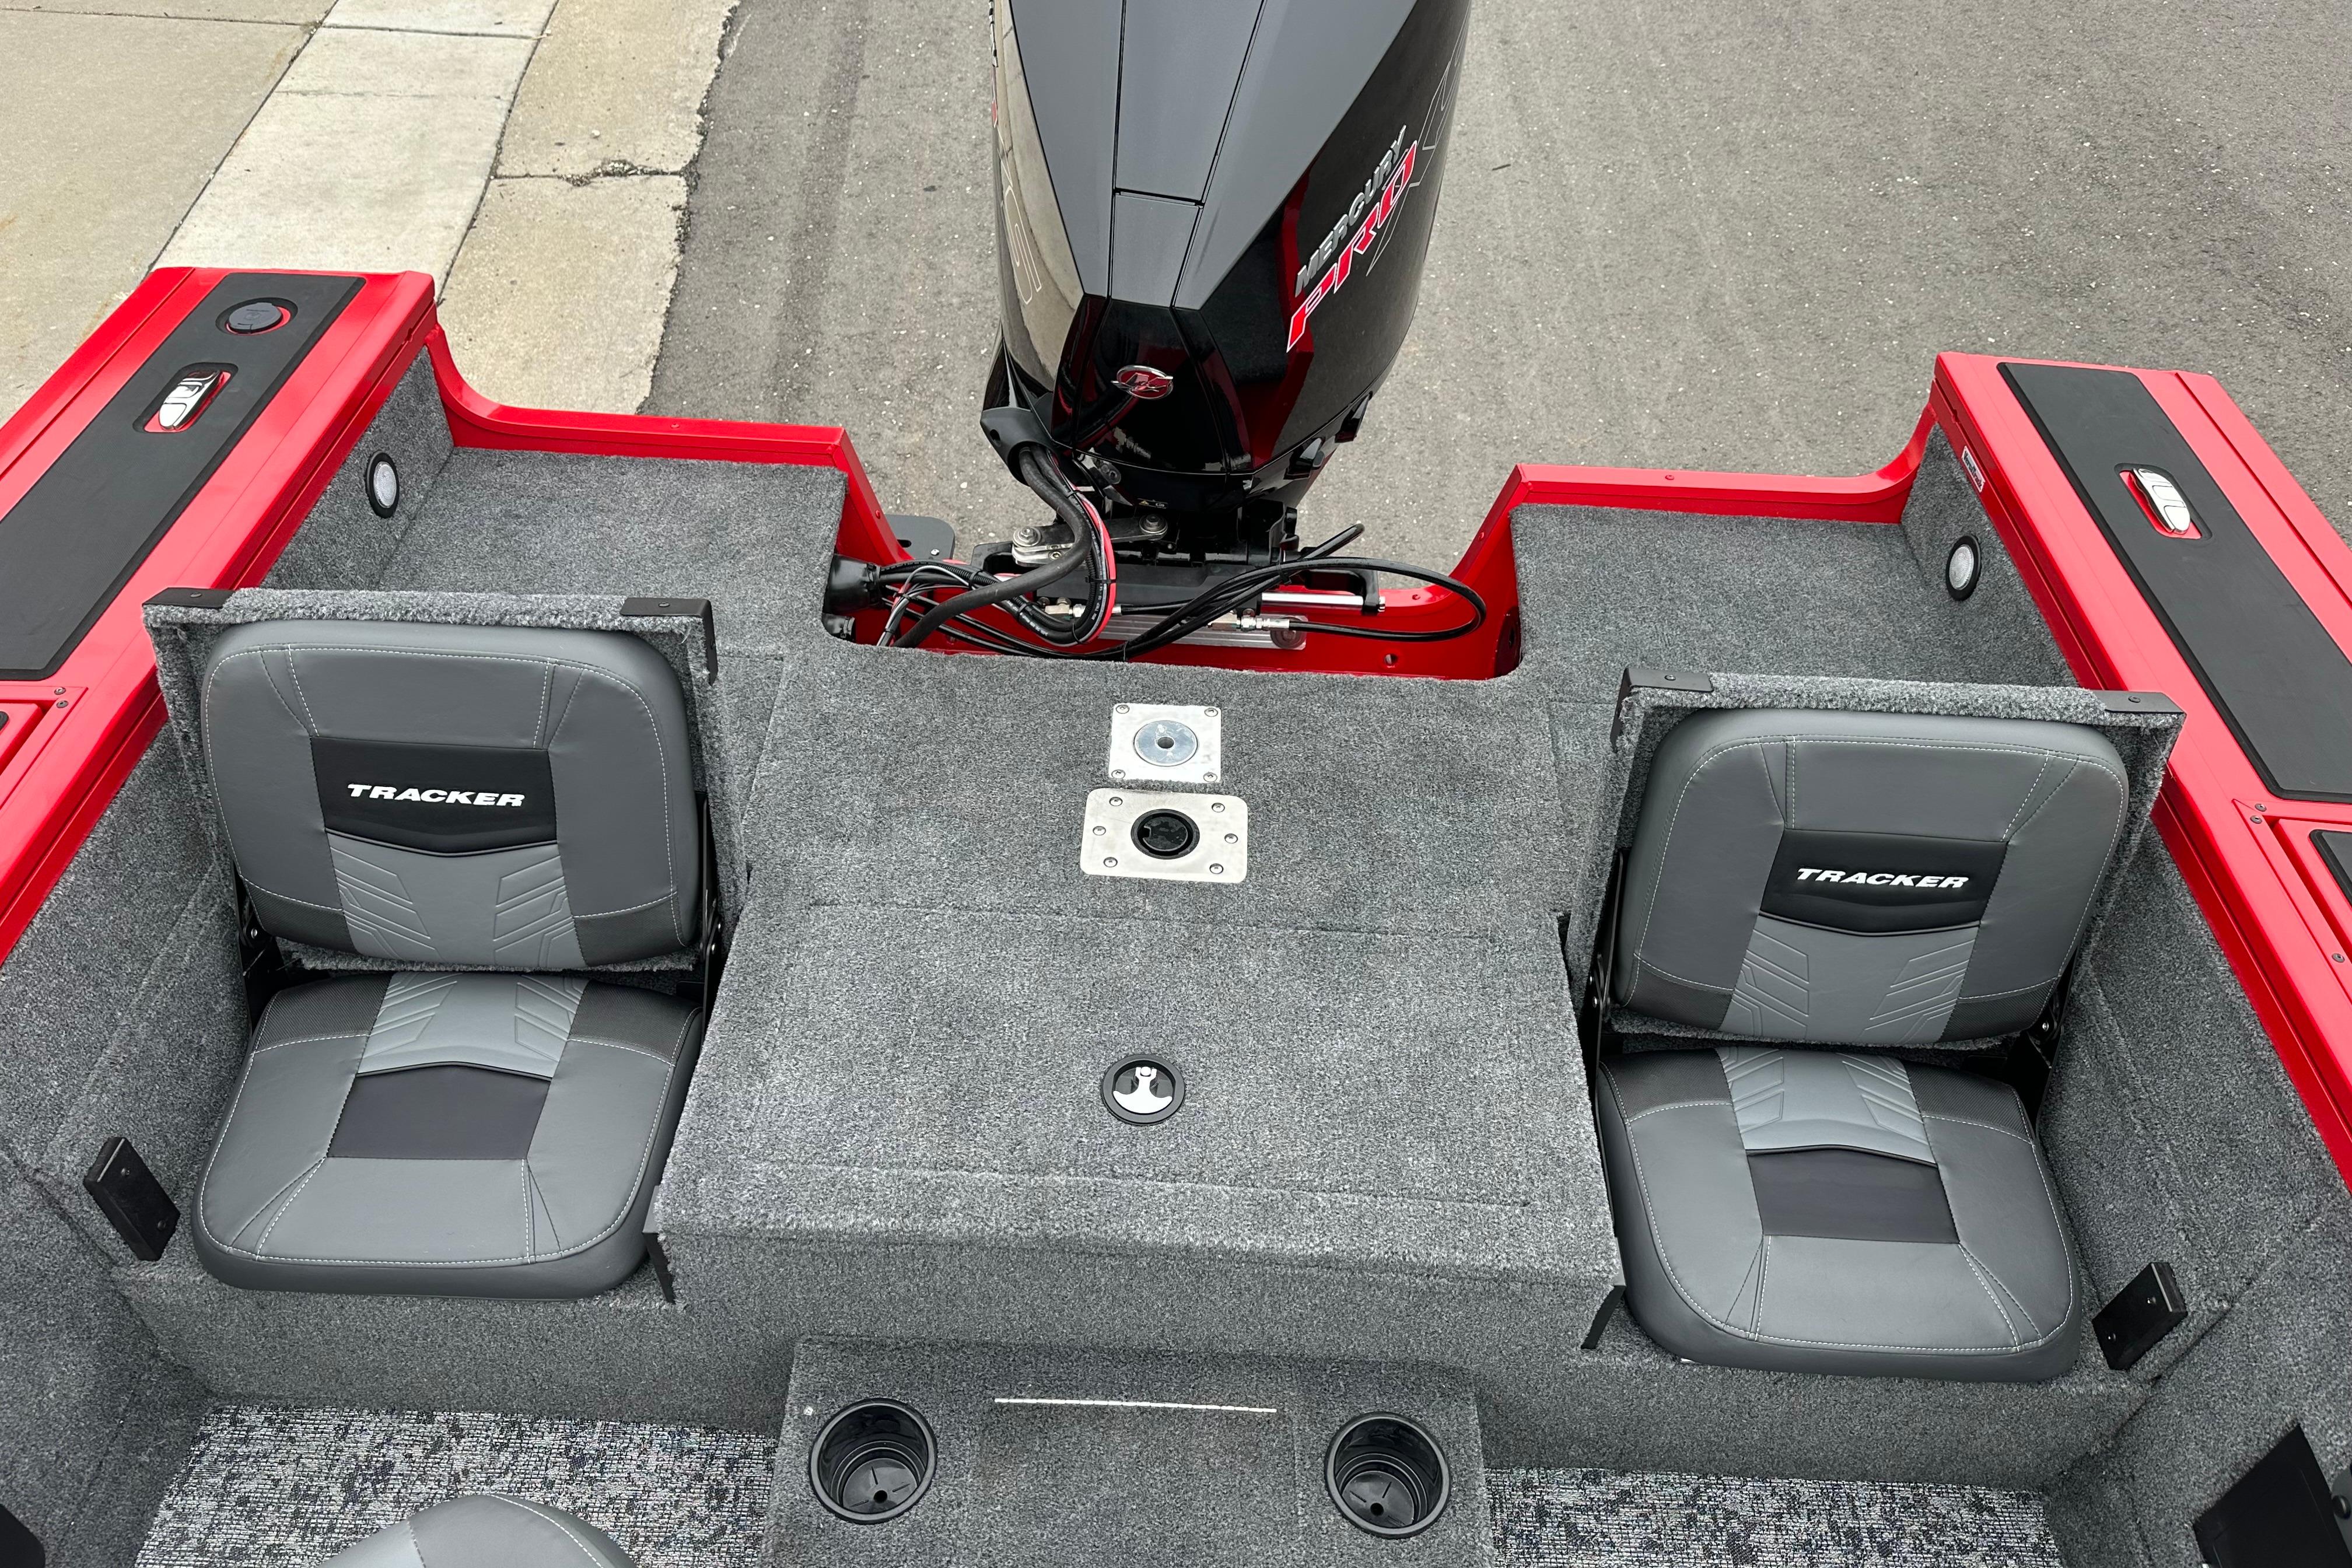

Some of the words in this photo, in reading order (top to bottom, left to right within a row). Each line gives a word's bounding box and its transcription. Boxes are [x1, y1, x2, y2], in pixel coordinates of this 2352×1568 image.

[1287, 141, 1418, 353] PRO
[1295, 125, 1407, 298] MERCURY
[348, 784, 525, 807] TRACKER
[1797, 868, 1969, 888] TRACKER
